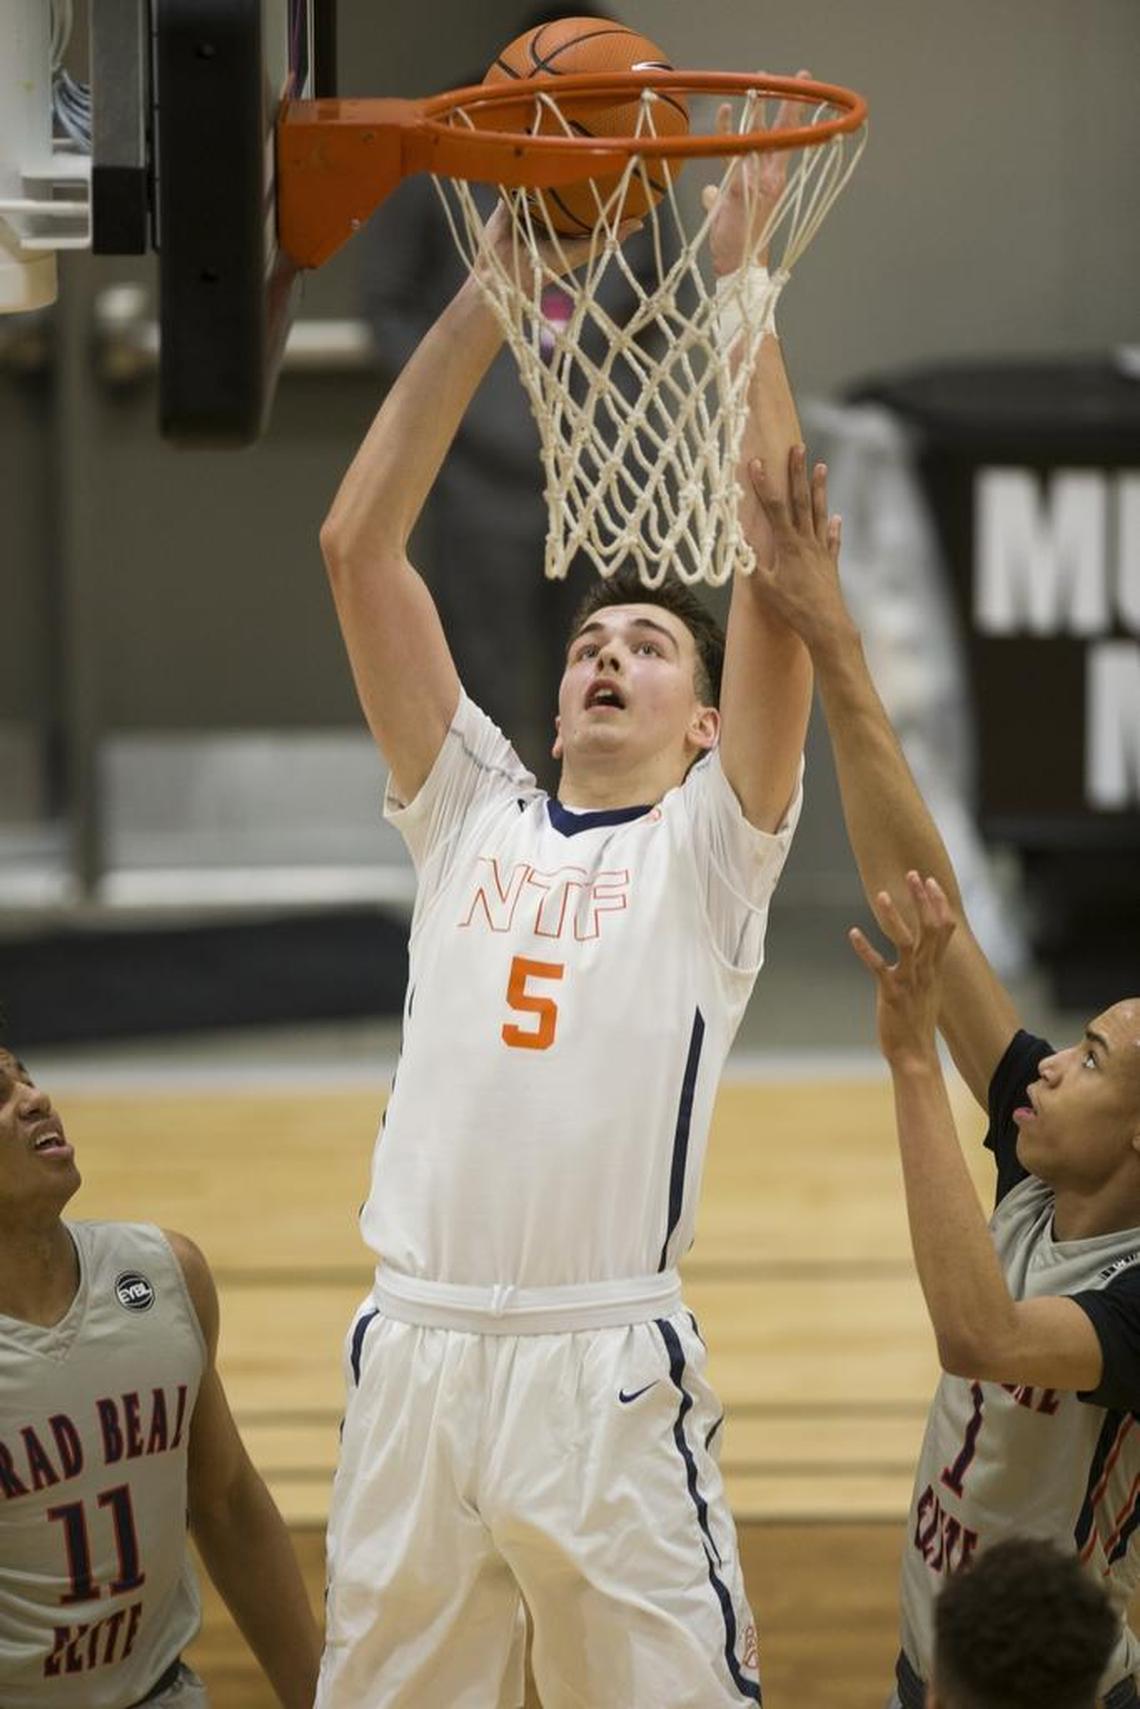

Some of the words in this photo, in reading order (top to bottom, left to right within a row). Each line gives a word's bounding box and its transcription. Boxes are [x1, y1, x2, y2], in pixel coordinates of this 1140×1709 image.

[974, 465, 1140, 638] M
[457, 856, 630, 942] NTF
[501, 955, 565, 1051] 5
[47, 1483, 146, 1605] 11
